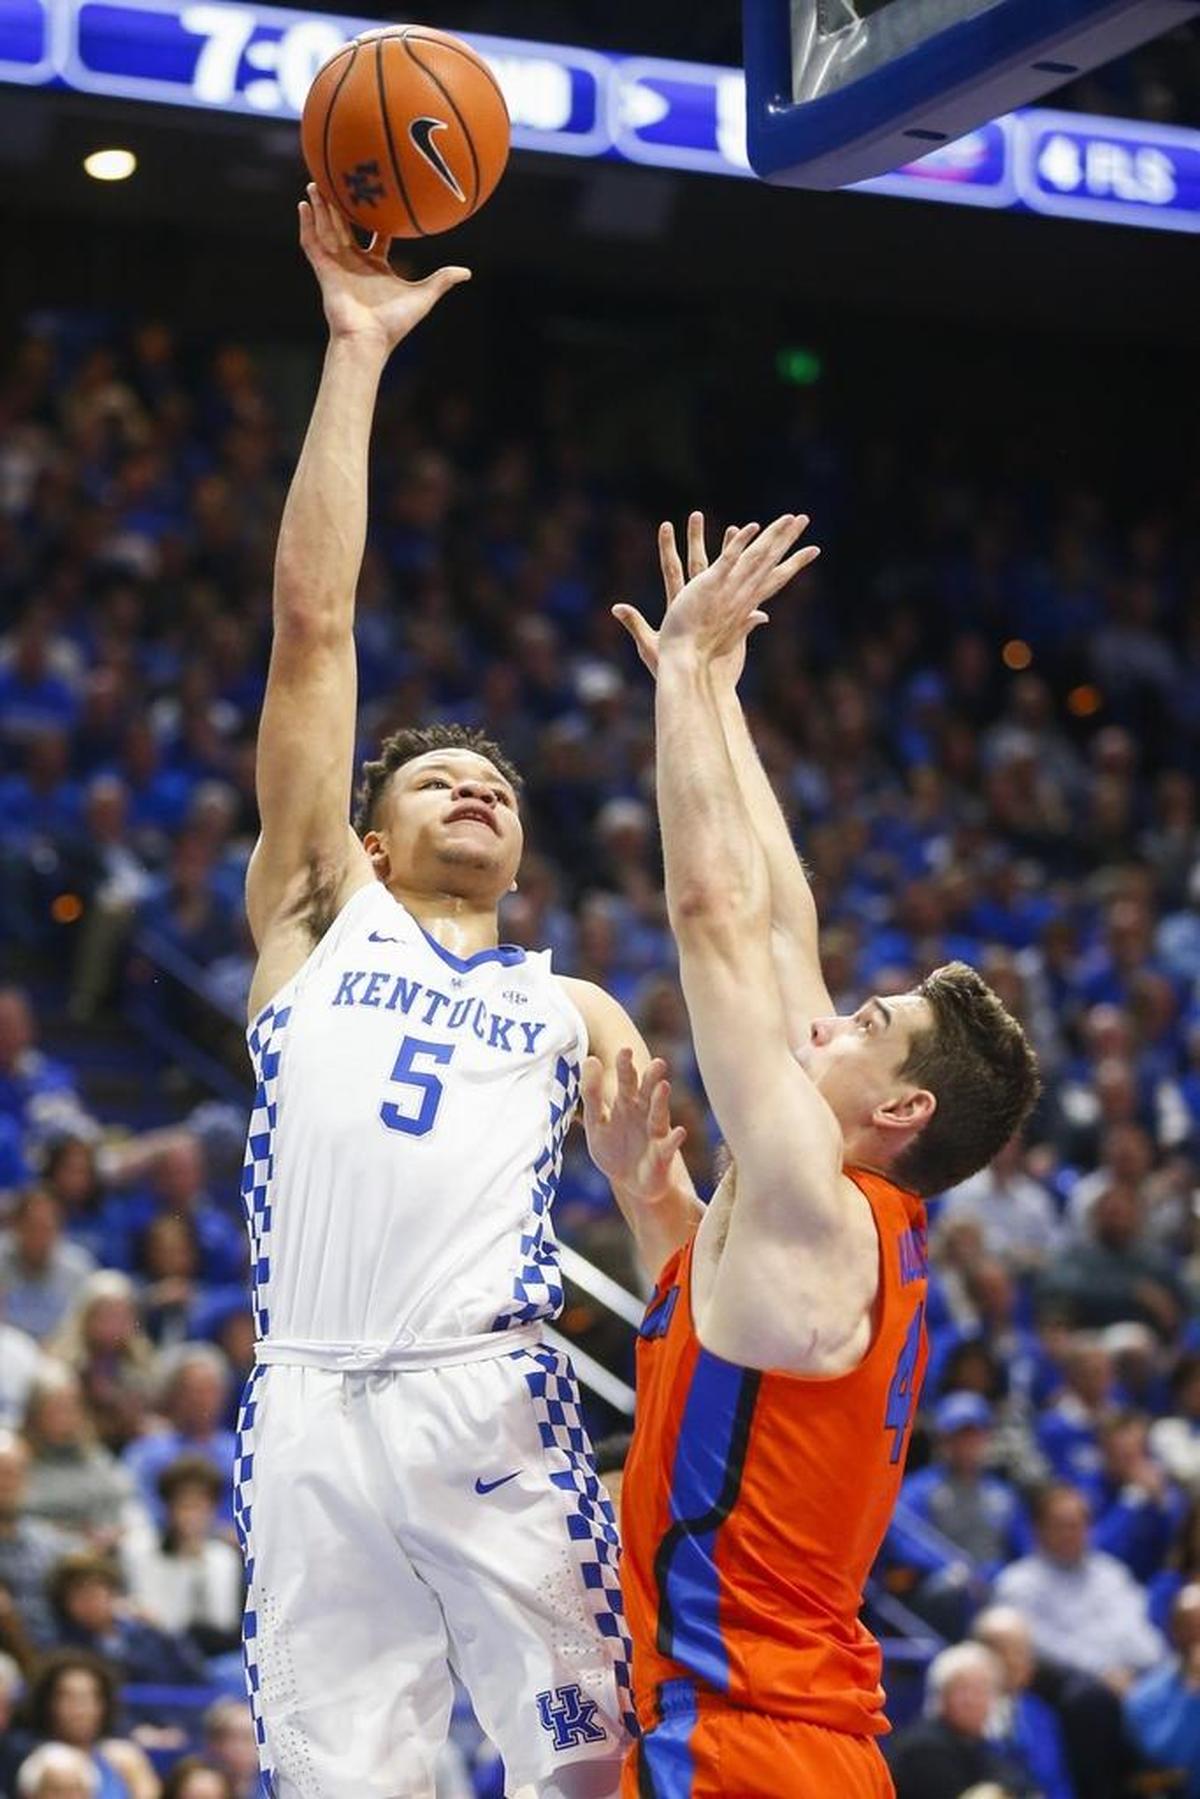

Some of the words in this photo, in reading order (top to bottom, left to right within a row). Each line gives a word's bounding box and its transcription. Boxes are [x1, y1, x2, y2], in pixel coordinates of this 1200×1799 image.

[332, 971, 546, 1054] KENTUCKY
[379, 1034, 456, 1137] 5
[535, 1684, 606, 1751] UK
